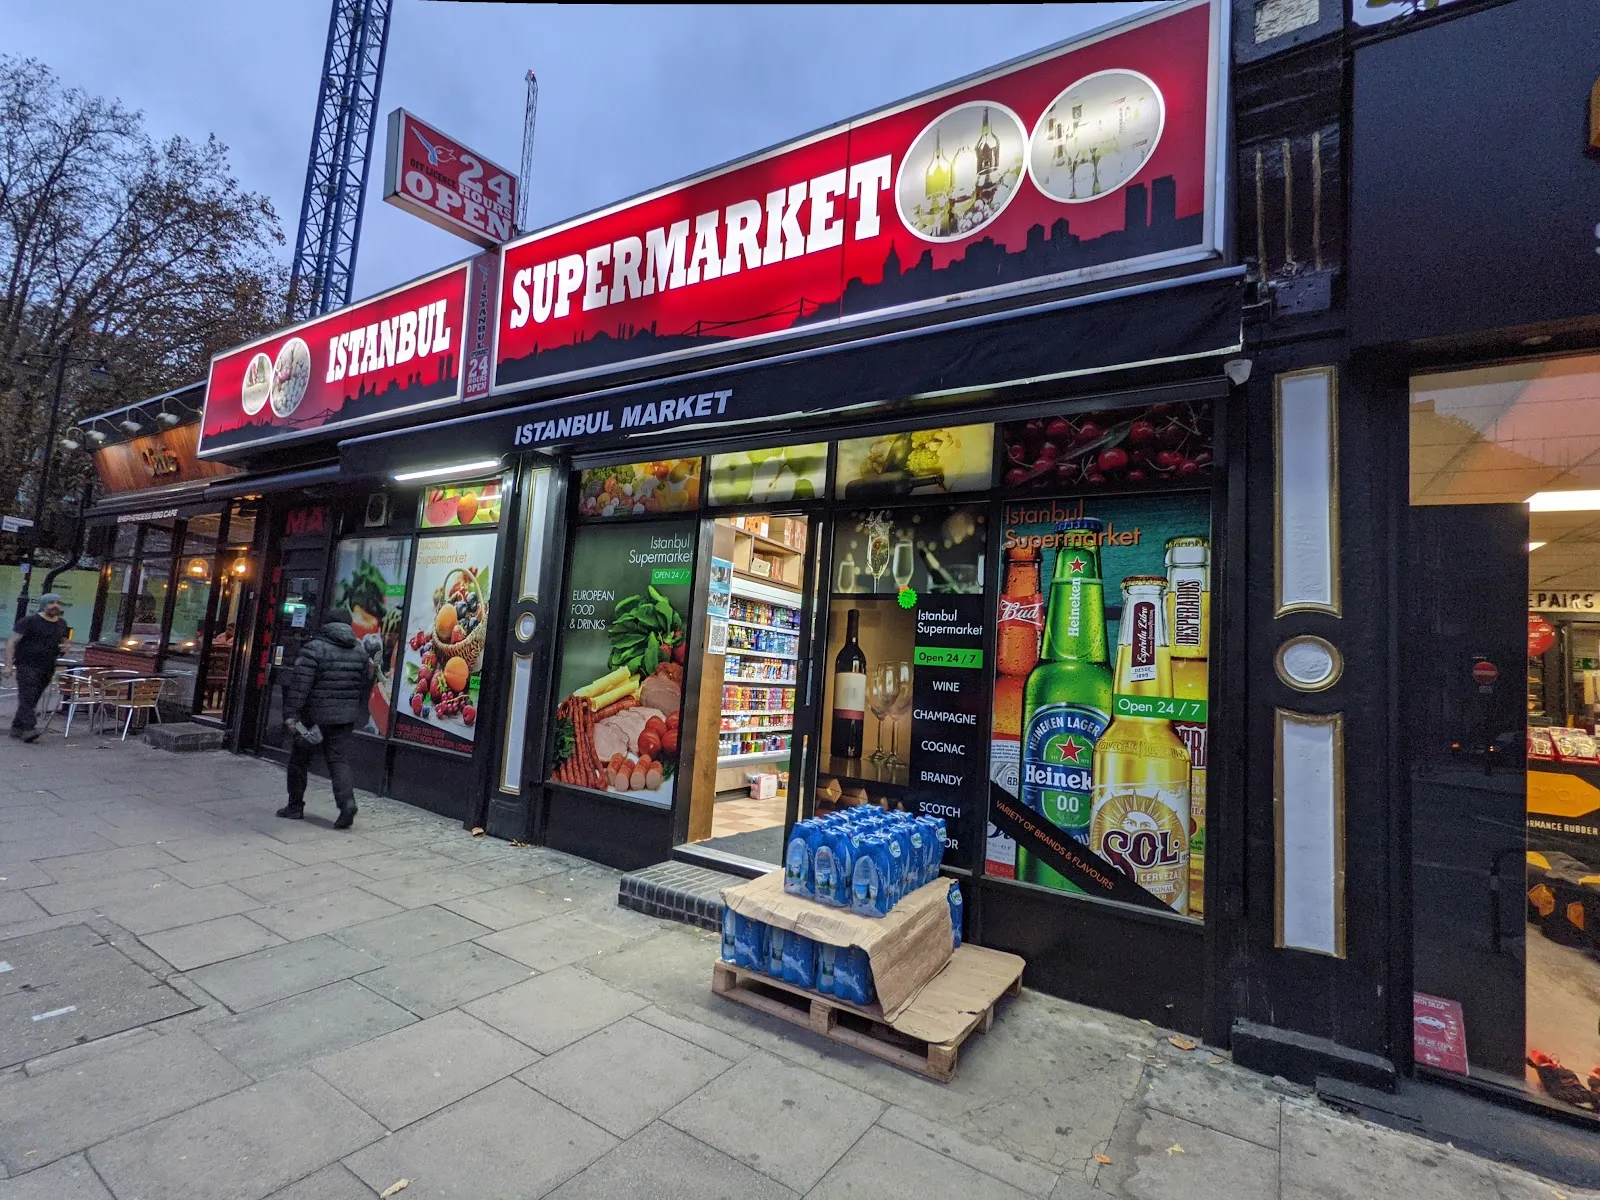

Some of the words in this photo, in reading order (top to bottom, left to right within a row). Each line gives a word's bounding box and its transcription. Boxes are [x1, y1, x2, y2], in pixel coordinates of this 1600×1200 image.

[458, 154, 512, 209] 24
[405, 171, 511, 241] OPEN
[458, 182, 511, 220] HOURS
[509, 154, 893, 330] SUPERMARKET
[476, 284, 488, 350] ISTANBUL
[326, 298, 451, 384] ISTANBUL
[469, 356, 488, 378] 24
[467, 382, 487, 393] OPEN
[514, 410, 614, 446] ISTANBUL
[619, 388, 733, 429] MARKET
[1004, 499, 1084, 525] Istanbul
[650, 533, 690, 550] Istanbul
[1003, 522, 1142, 554] Supermarket
[417, 550, 468, 568] Supermarket
[628, 548, 694, 567] Supermarket
[654, 571, 670, 579] OPEN
[671, 571, 679, 579] 24
[572, 590, 615, 601] EUROPEAN
[571, 604, 595, 615] FOOD
[917, 609, 958, 622] Istanbul
[999, 599, 1043, 622] Bud
[1067, 576, 1081, 638] Heineken
[1174, 579, 1202, 646] DESPERADOS
[570, 618, 576, 629] &
[577, 619, 606, 630] DRINKS
[917, 622, 983, 637] Supermarket
[918, 652, 945, 663] Open
[946, 653, 959, 664] 24
[960, 653, 969, 666] /
[970, 654, 976, 664] 7
[932, 680, 960, 692] WINE
[1118, 698, 1153, 714] Open
[1157, 701, 1175, 714] 24
[1178, 702, 1187, 716] /
[1191, 703, 1201, 716] 7
[913, 709, 977, 725] CHAMPAGNE
[1029, 716, 1065, 751] HEINEKEN
[1067, 716, 1101, 737] LAGER
[921, 740, 966, 756] COGNAC
[920, 770, 963, 786] BRANDY
[1024, 764, 1092, 791] Heinek
[919, 802, 961, 819] SCOTCH
[1056, 795, 1079, 813] 0.0
[1564, 824, 1598, 836] RUBBER
[996, 800, 1025, 824] VARIETY
[1023, 818, 1037, 834] OF
[1033, 829, 1066, 855] BRANDS
[1065, 851, 1072, 860] &
[1071, 855, 1115, 890] FLAVOURS
[1140, 870, 1179, 882] CERVEZA
